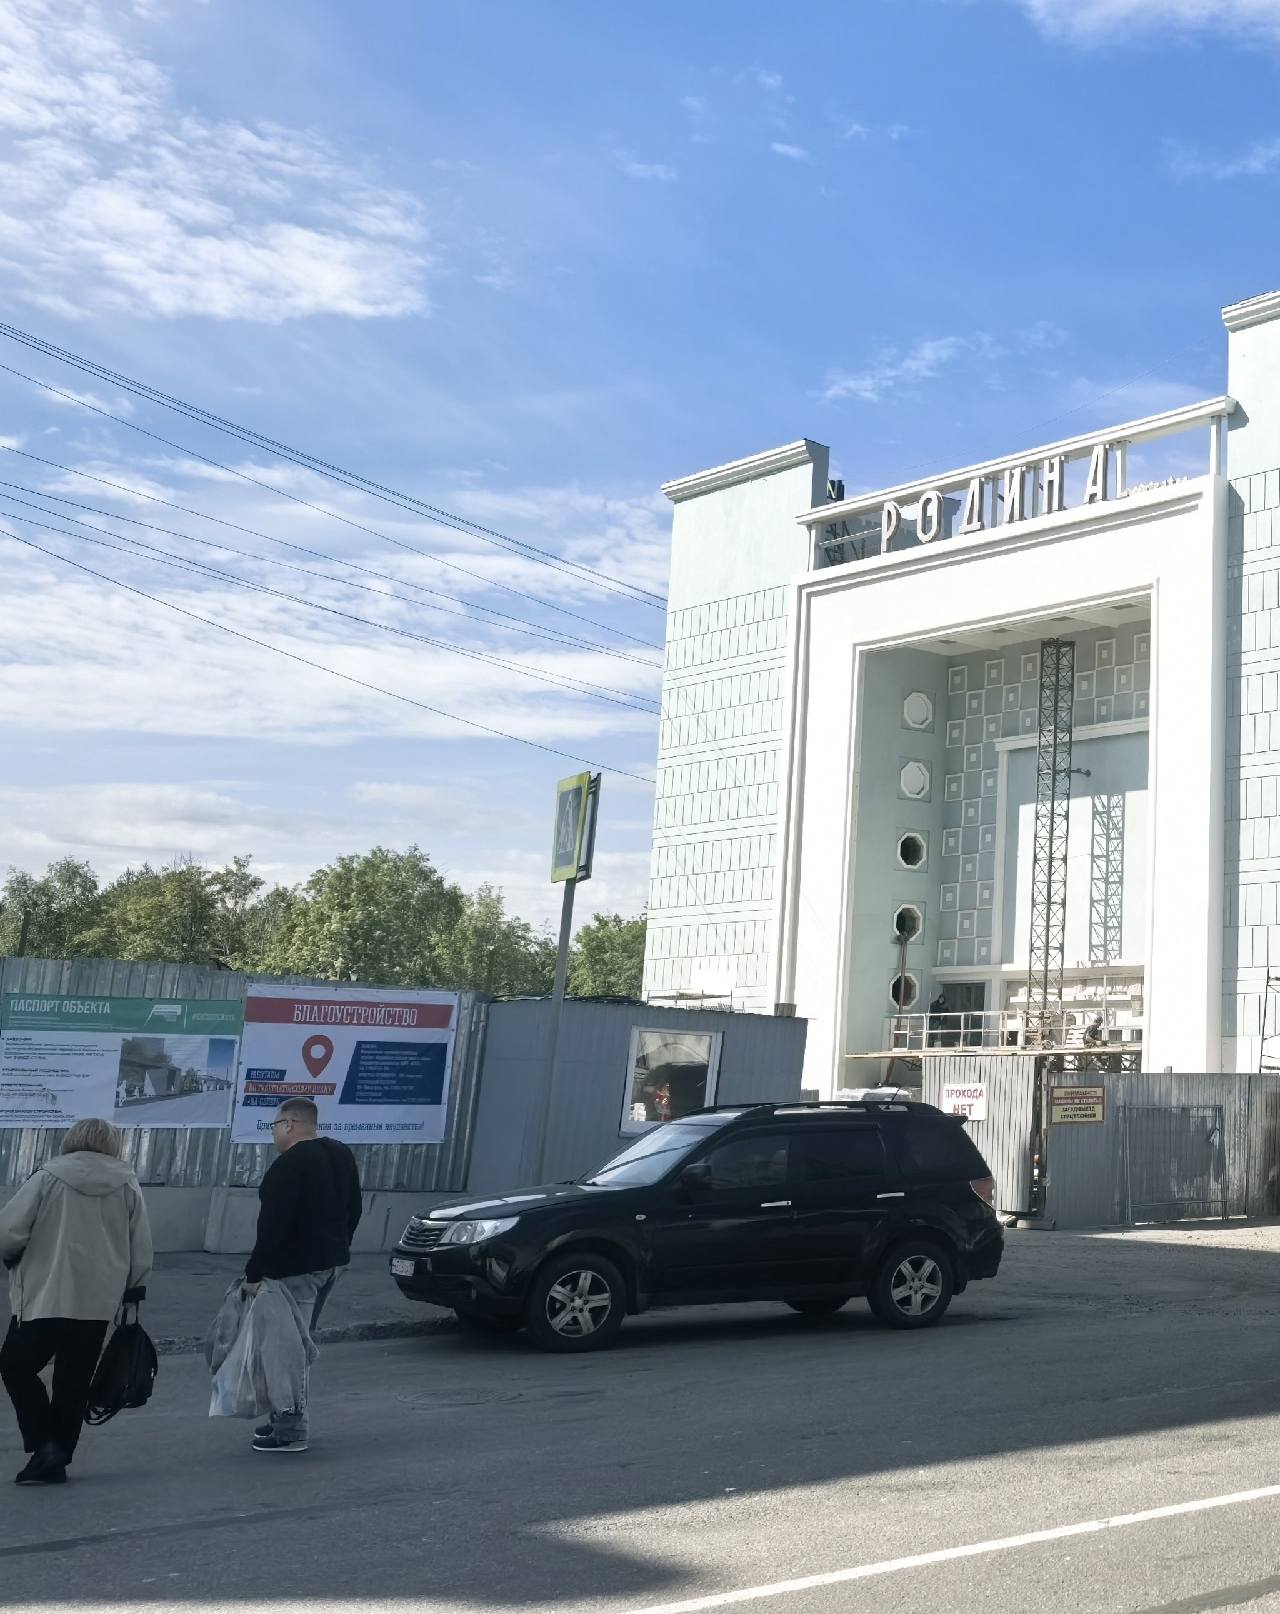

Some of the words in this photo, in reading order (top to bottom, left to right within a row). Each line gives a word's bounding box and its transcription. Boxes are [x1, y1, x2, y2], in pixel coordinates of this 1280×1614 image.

[881, 444, 1112, 554] РОДИНА
[10, 999, 60, 1012] ПАСПОРТ
[62, 1000, 111, 1014] ОБЪЕКТА
[293, 1003, 418, 1026] БЛАГОУСТРОЙСТВО
[945, 1088, 984, 1100] ПРОХОДА
[953, 1103, 974, 1116] НЕТ
